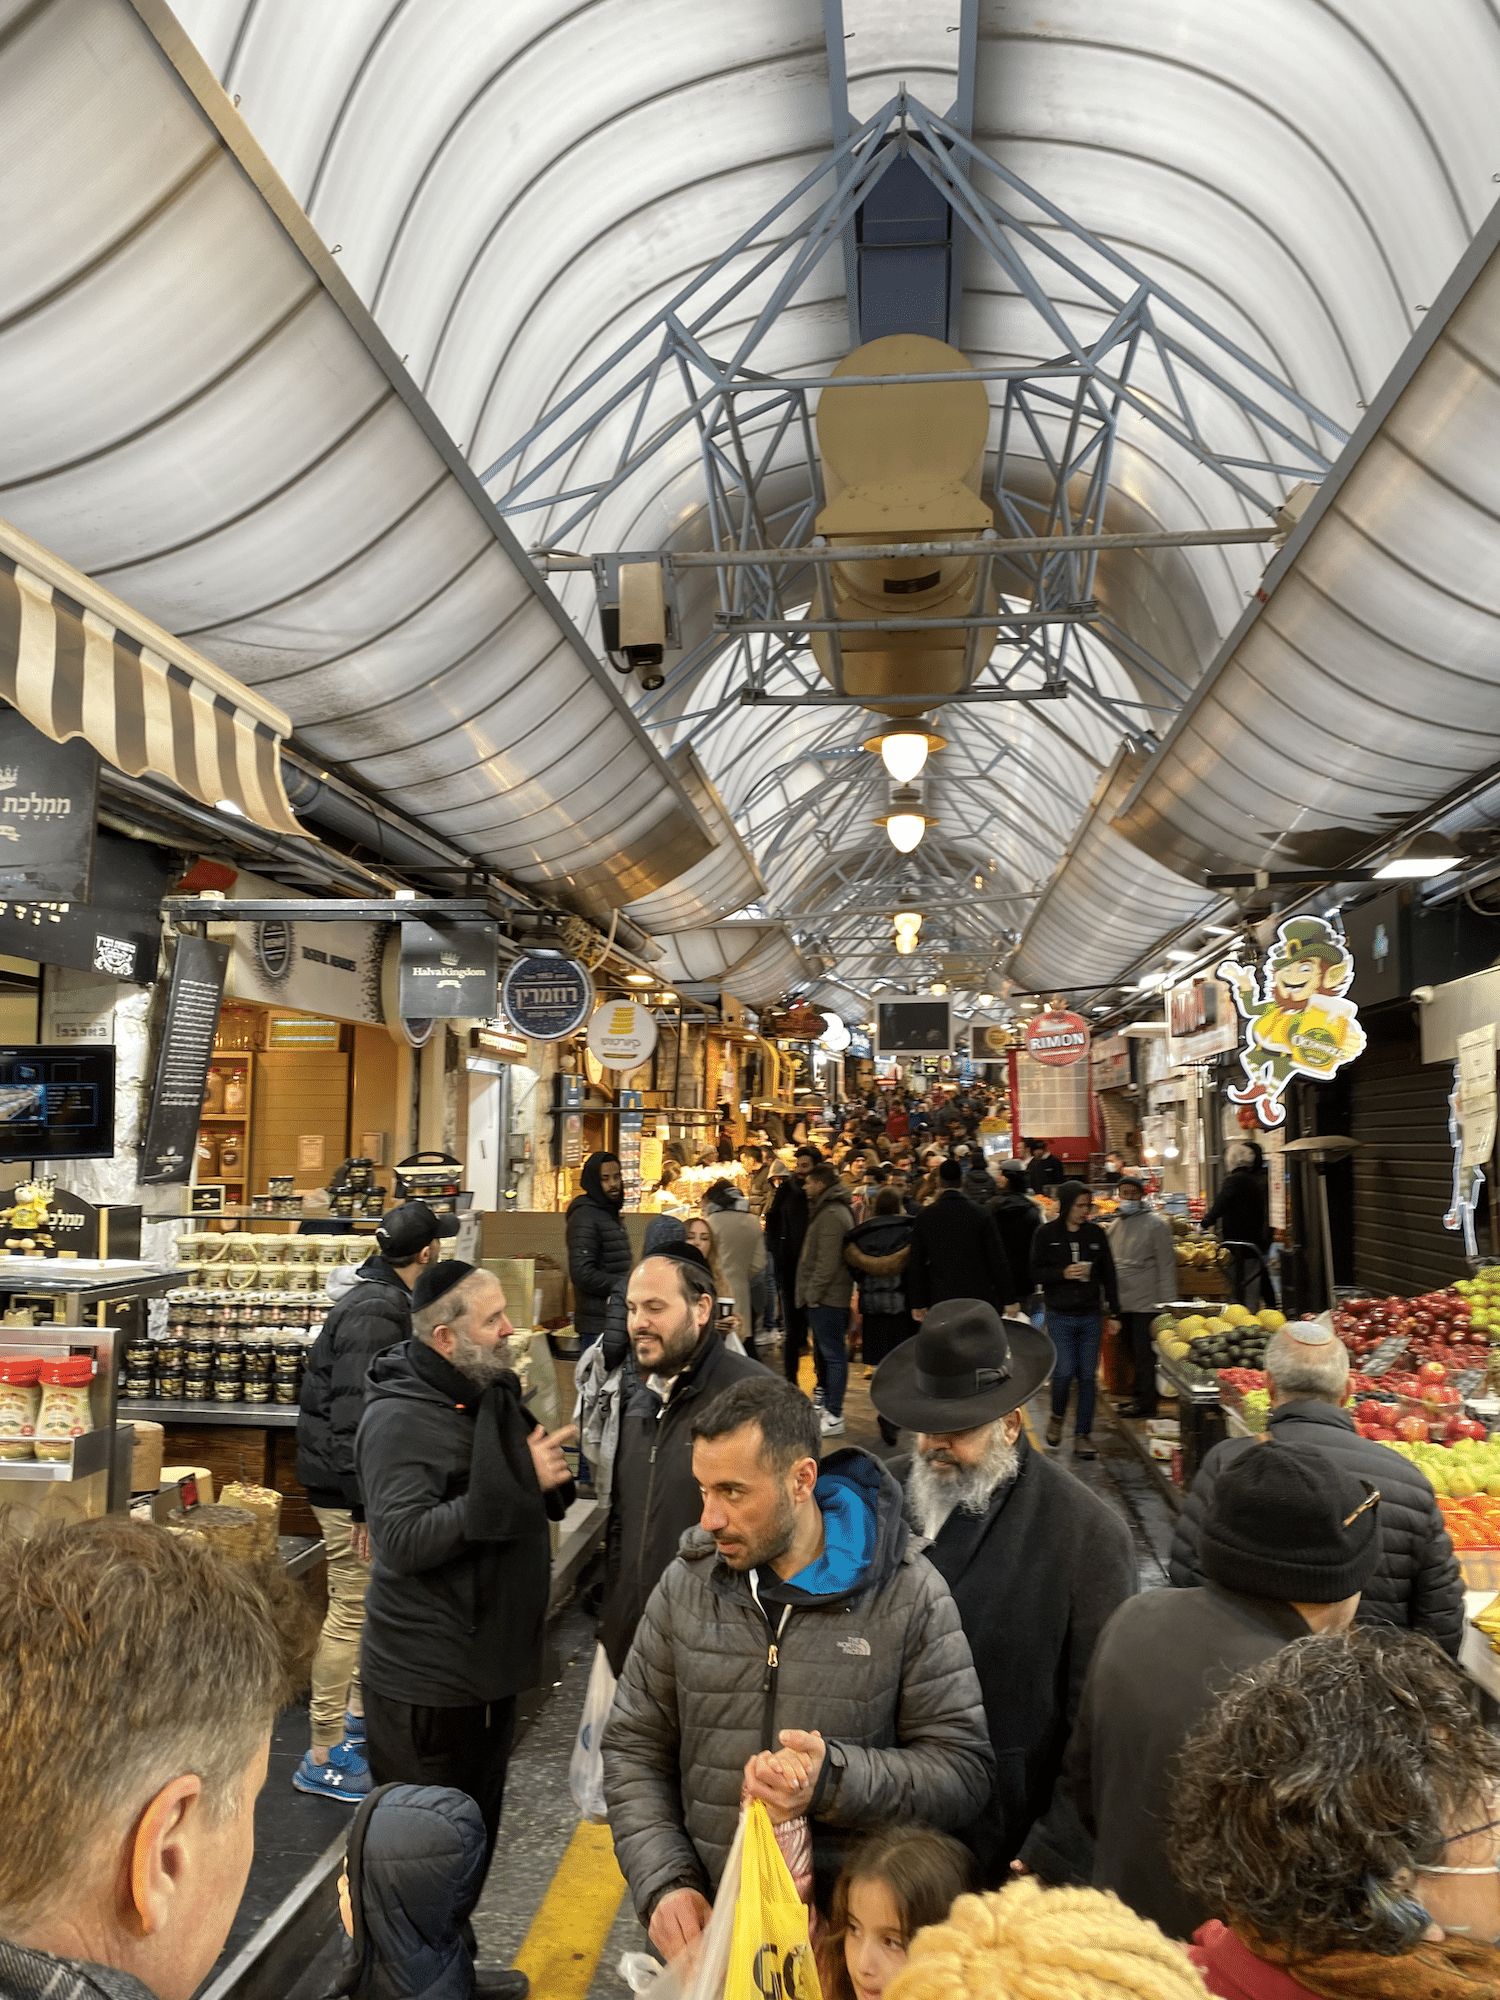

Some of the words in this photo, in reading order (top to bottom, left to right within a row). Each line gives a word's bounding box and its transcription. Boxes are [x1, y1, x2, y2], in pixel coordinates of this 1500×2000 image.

[412, 966, 486, 979] HalvaKingdom
[515, 987, 579, 1010] רוזמרין
[1029, 1032, 1085, 1050] RIMON
